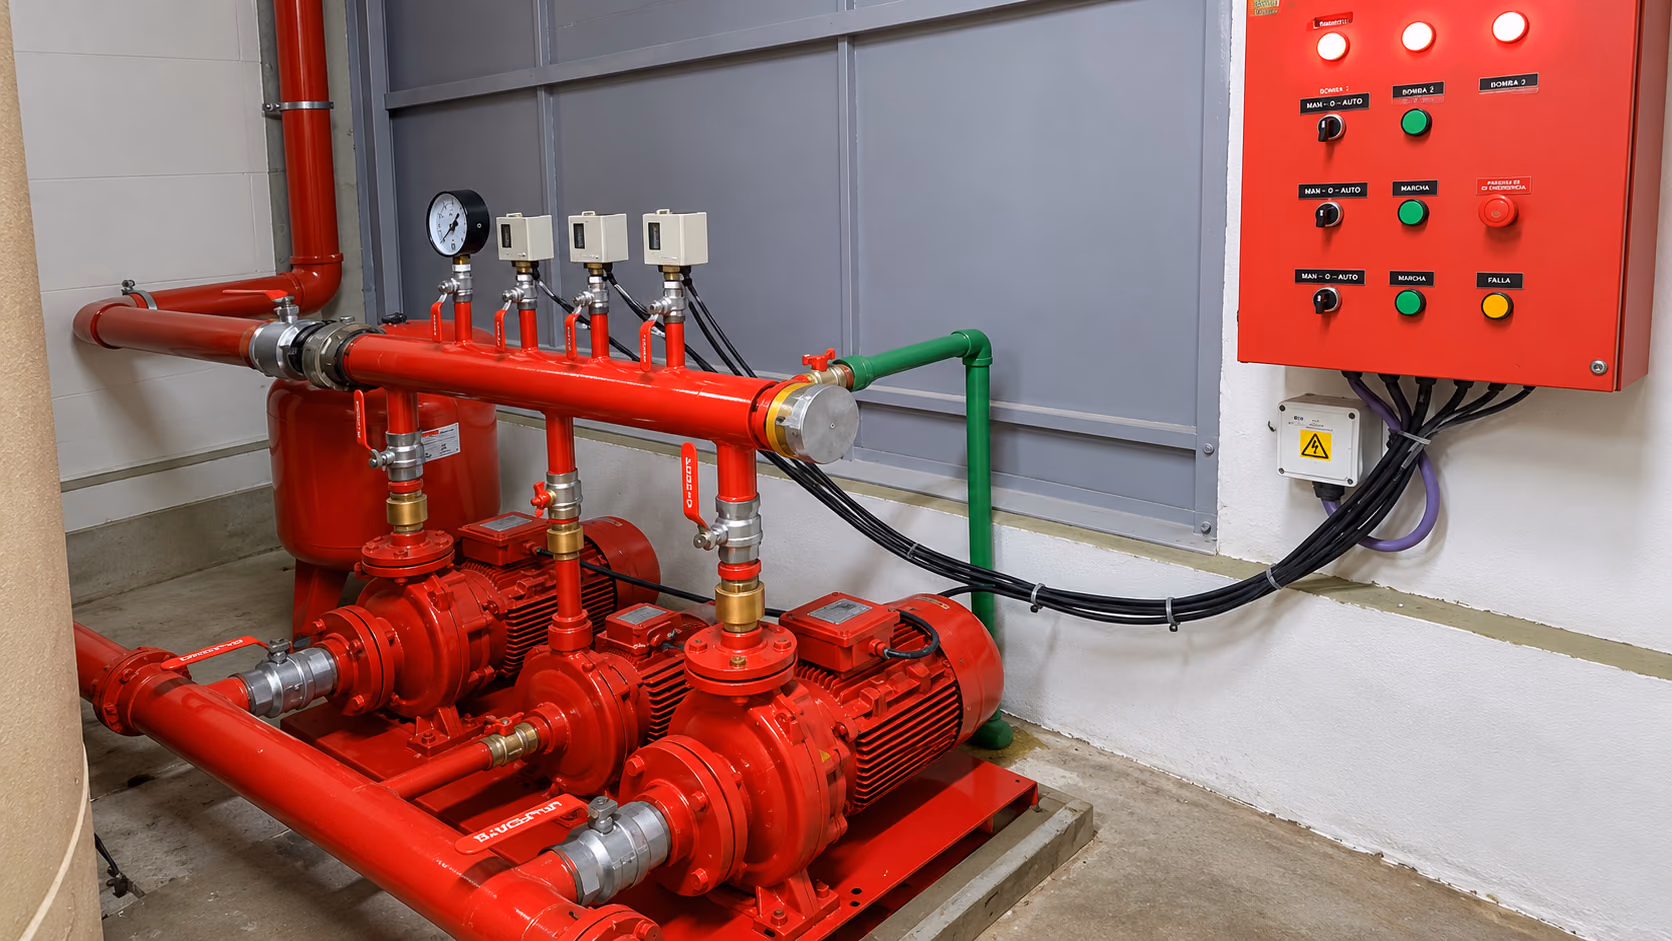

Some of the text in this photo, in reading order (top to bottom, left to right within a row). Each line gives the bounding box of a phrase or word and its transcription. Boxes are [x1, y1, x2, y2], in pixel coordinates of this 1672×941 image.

[1402, 85, 1435, 96] BOMBA 2
[1306, 101, 1323, 109] MAN
[1342, 97, 1363, 106] AUTO
[1304, 187, 1321, 195] MAN
[1340, 186, 1361, 194] AUTO
